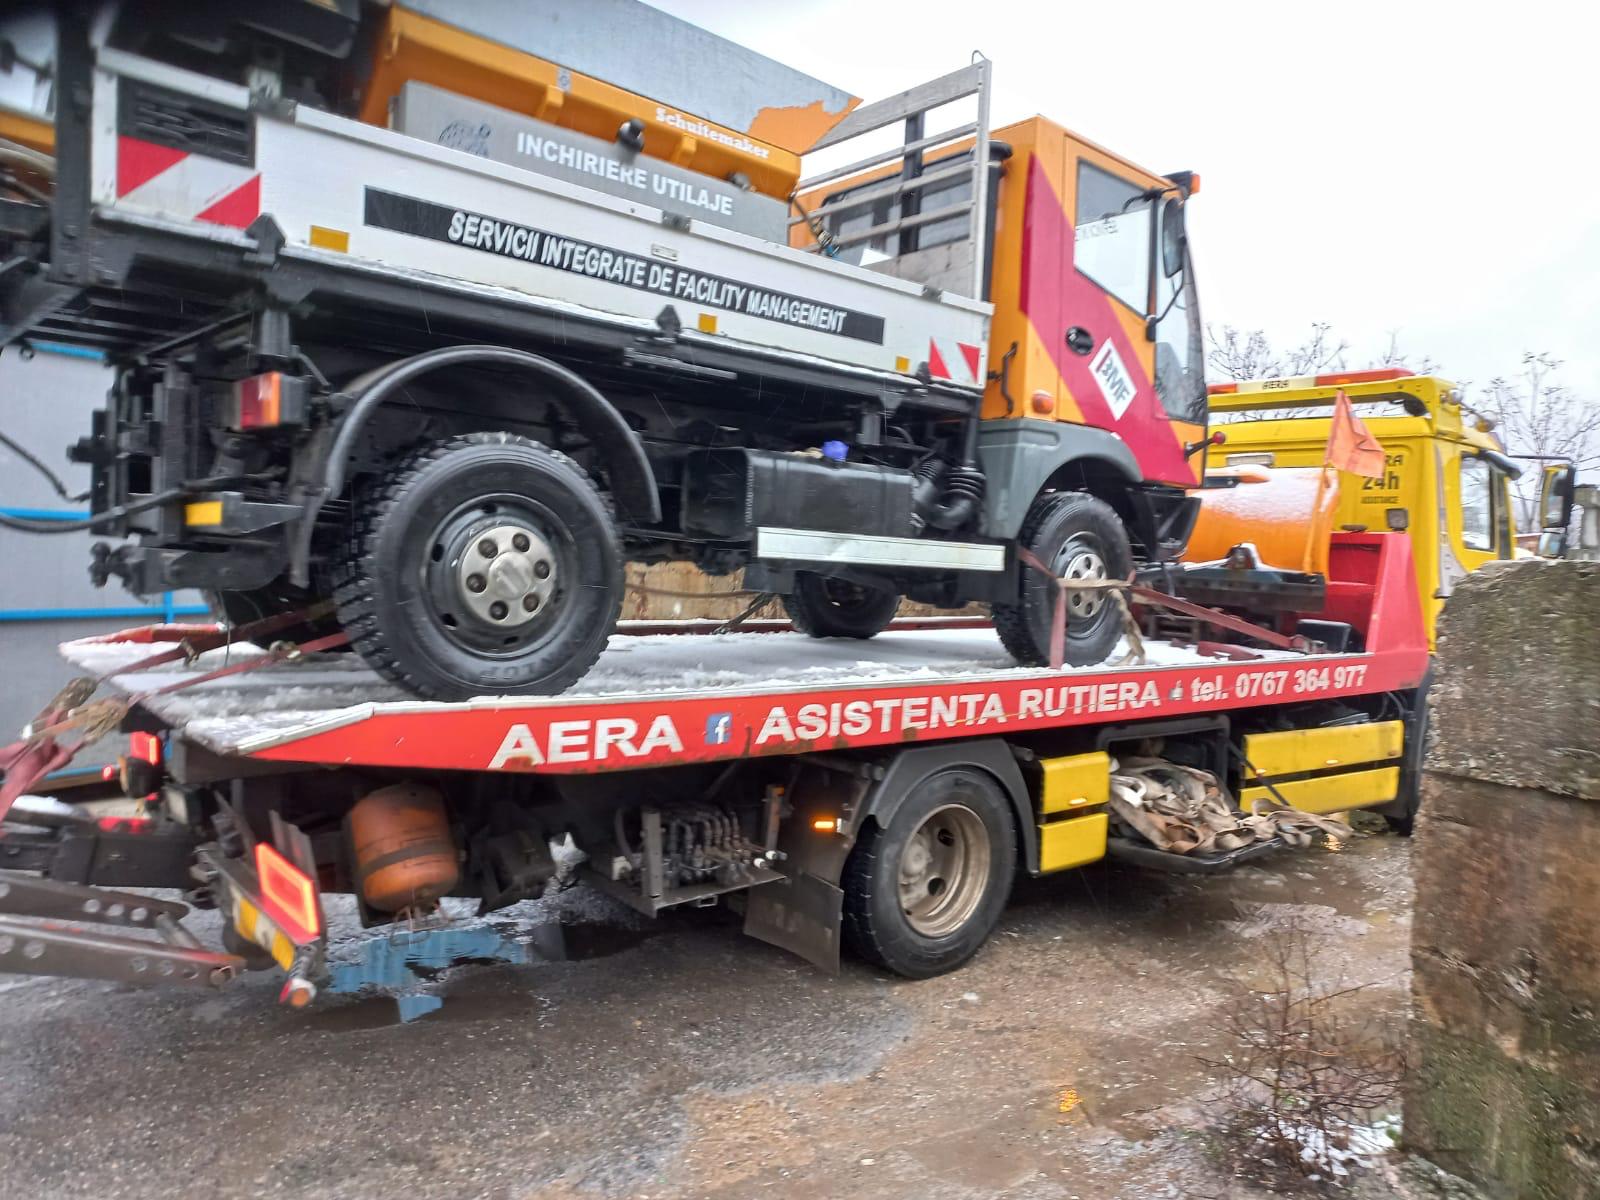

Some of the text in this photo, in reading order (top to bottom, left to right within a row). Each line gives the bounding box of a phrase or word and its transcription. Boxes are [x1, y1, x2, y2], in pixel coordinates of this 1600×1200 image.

[516, 131, 648, 190] INCHIRIERE
[651, 173, 733, 215] UTILAJE
[655, 106, 771, 160] Schuitemaker
[447, 211, 848, 333] SERVICII INTEGRATE DE FACILITY MANAGEMENT
[1361, 471, 1400, 490] 24h
[488, 714, 684, 770] AERA
[754, 694, 1007, 745] ASISTENTA
[1020, 679, 1161, 719] RUTIERA
[1191, 675, 1229, 704] tel.
[1236, 668, 1286, 699] 0767
[1294, 666, 1330, 693] 364
[1333, 663, 1368, 690] 977
